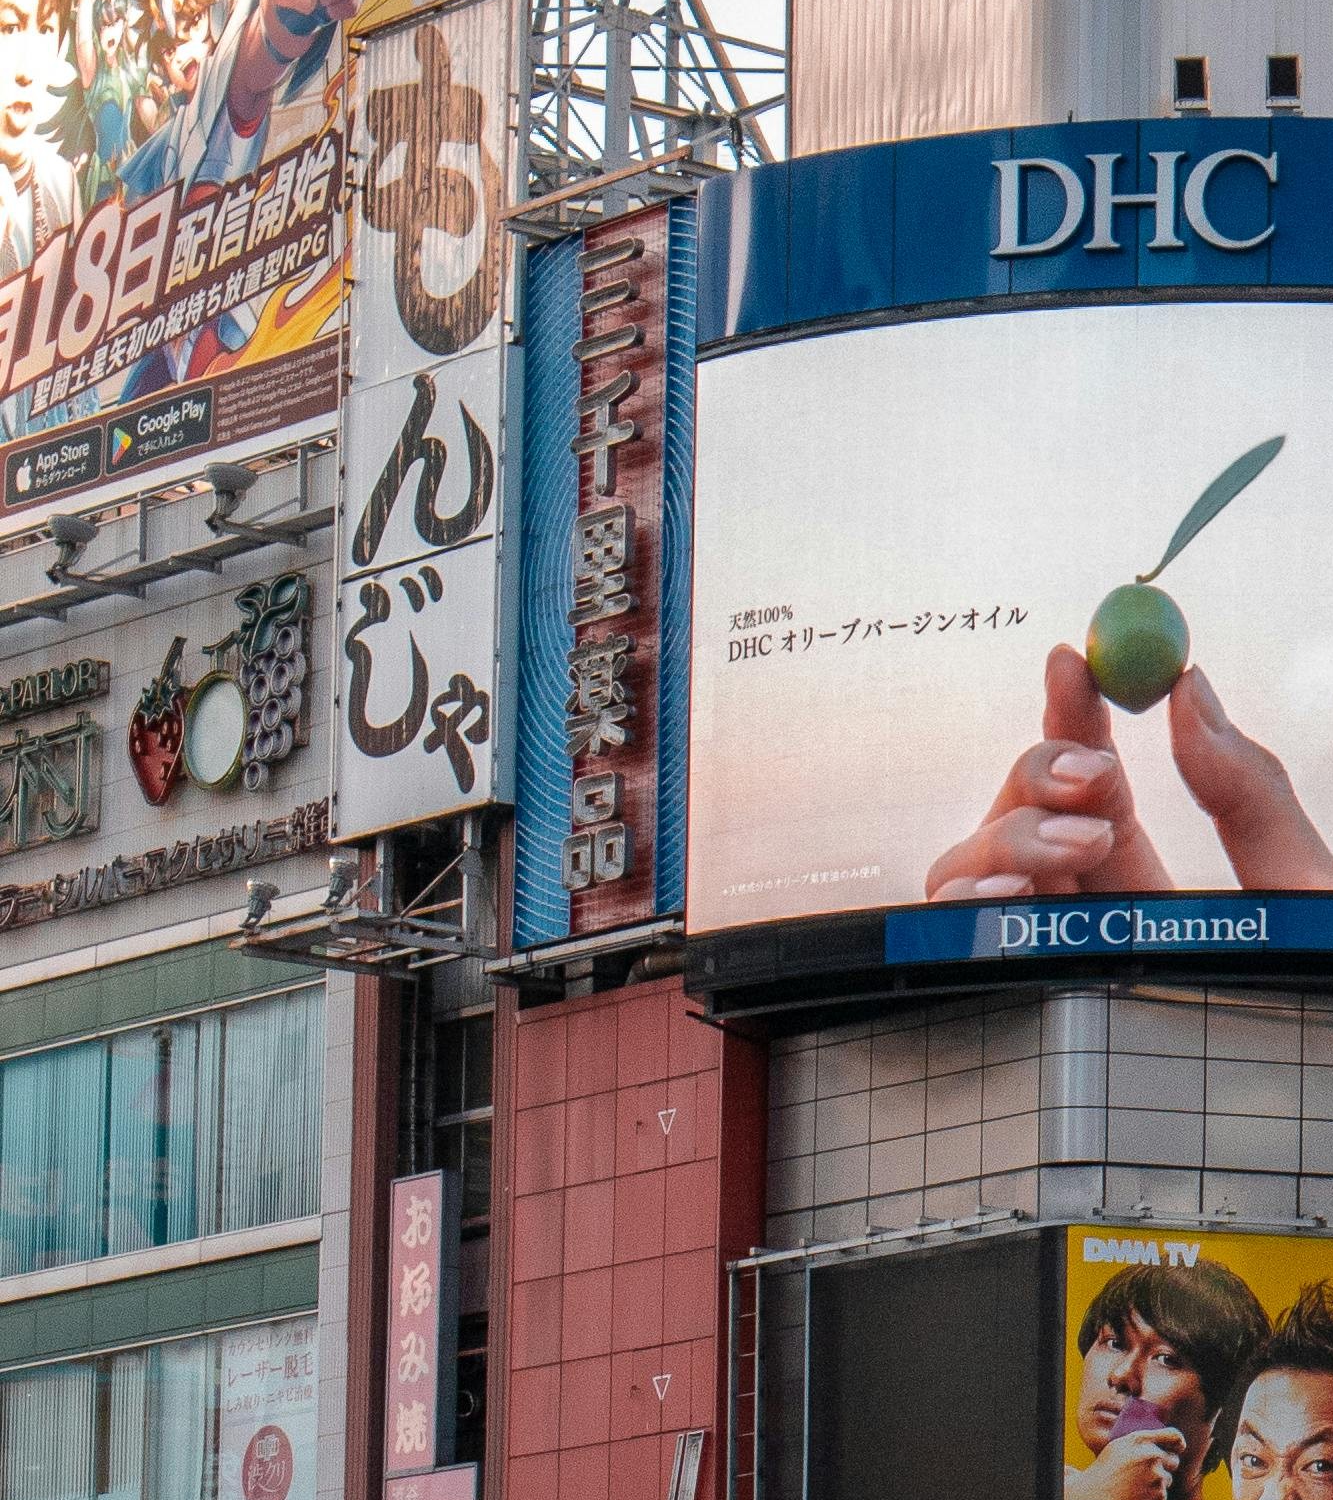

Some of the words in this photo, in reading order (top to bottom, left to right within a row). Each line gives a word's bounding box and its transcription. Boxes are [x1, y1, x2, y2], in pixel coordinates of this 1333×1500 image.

[989, 148, 1280, 257] DHC
[33, 225, 332, 415] 聖闘士星矢初の縦持ち放置型RPG
[137, 406, 180, 436] Google
[181, 397, 207, 429] Play
[344, 24, 504, 793] もんじゃ
[36, 445, 60, 472] App
[62, 441, 90, 463] Store
[562, 235, 644, 891] 三千里薬品
[727, 604, 795, 634] 天然100%
[727, 632, 775, 664] DHC
[780, 604, 1030, 654] オリーブバージンオイル
[11, 658, 94, 712] PARLOR
[999, 911, 1091, 949] DHC
[1099, 907, 1270, 944] Channel
[1083, 1237, 1161, 1264] DMM
[1164, 1240, 1200, 1267] TV
[393, 1196, 434, 1455] お好み焼
[225, 1351, 315, 1388] レーザー脱毛
